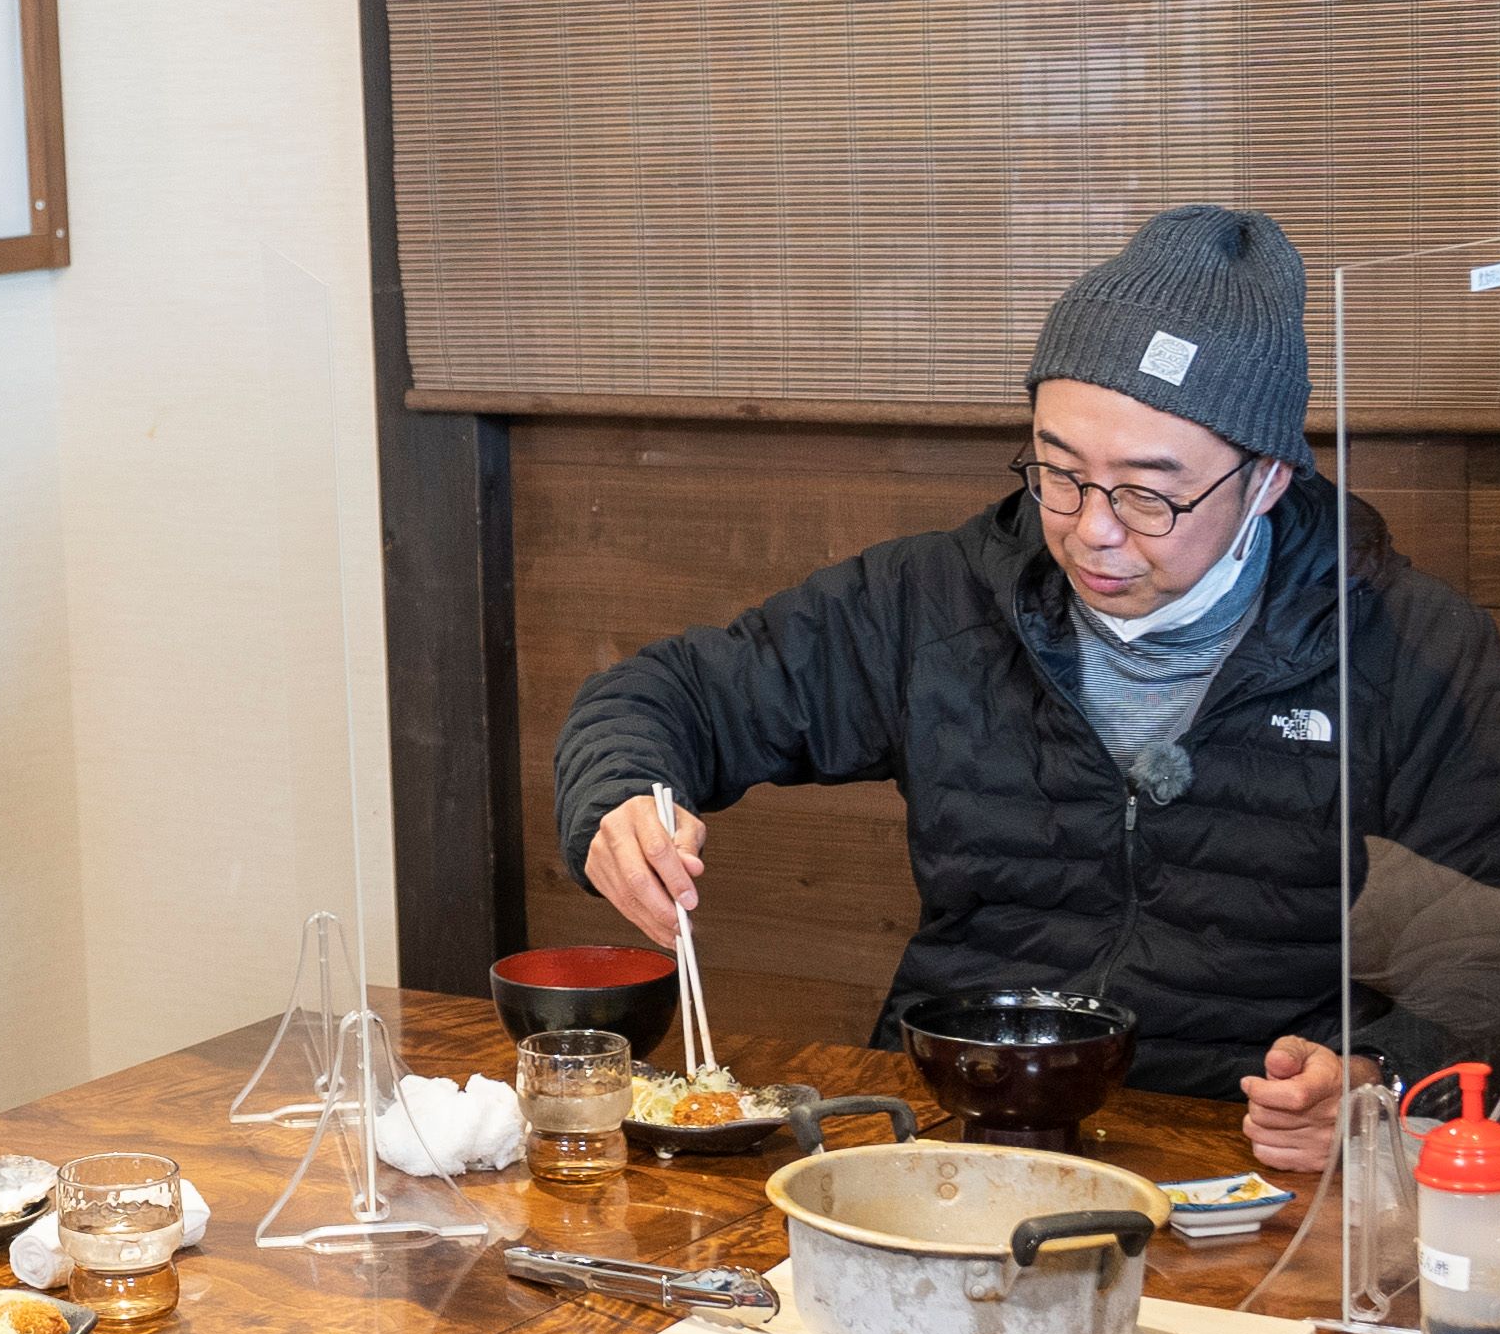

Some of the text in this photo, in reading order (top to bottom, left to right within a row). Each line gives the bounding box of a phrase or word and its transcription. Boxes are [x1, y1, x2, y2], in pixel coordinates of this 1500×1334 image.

[1290, 708, 1310, 720] THE
[1271, 714, 1309, 731] NORTH
[1282, 727, 1308, 741] FACE
